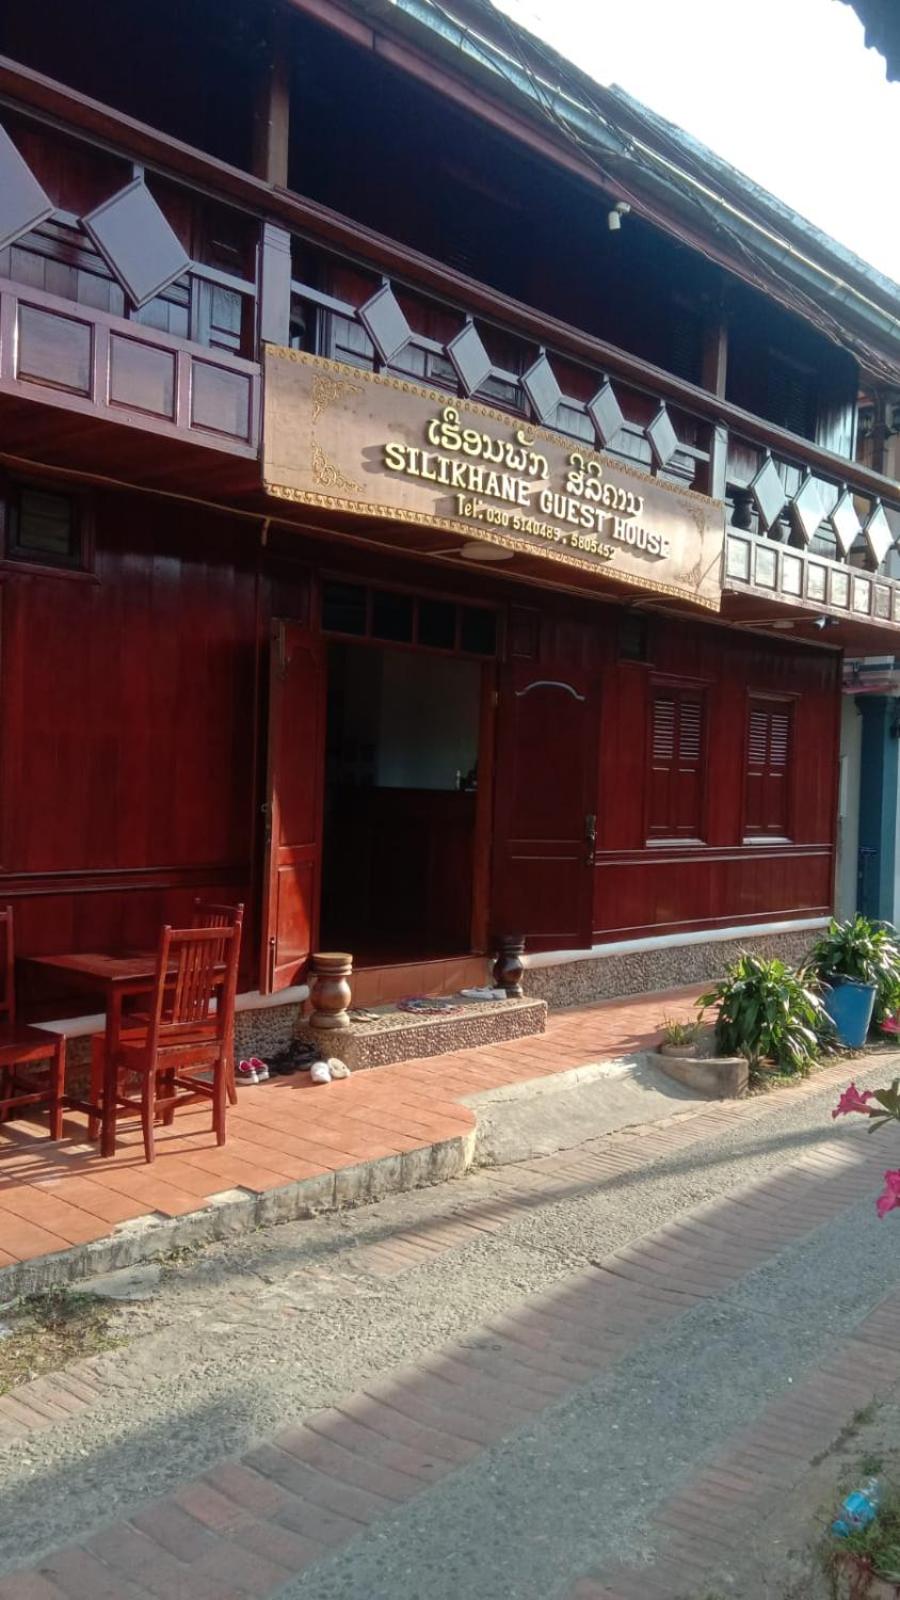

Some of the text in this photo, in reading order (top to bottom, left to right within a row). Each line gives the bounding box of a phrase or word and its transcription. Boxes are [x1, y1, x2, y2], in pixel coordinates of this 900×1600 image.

[385, 441, 670, 557] SILIKHANE GUEST HOUSE
[486, 508, 509, 526] 030
